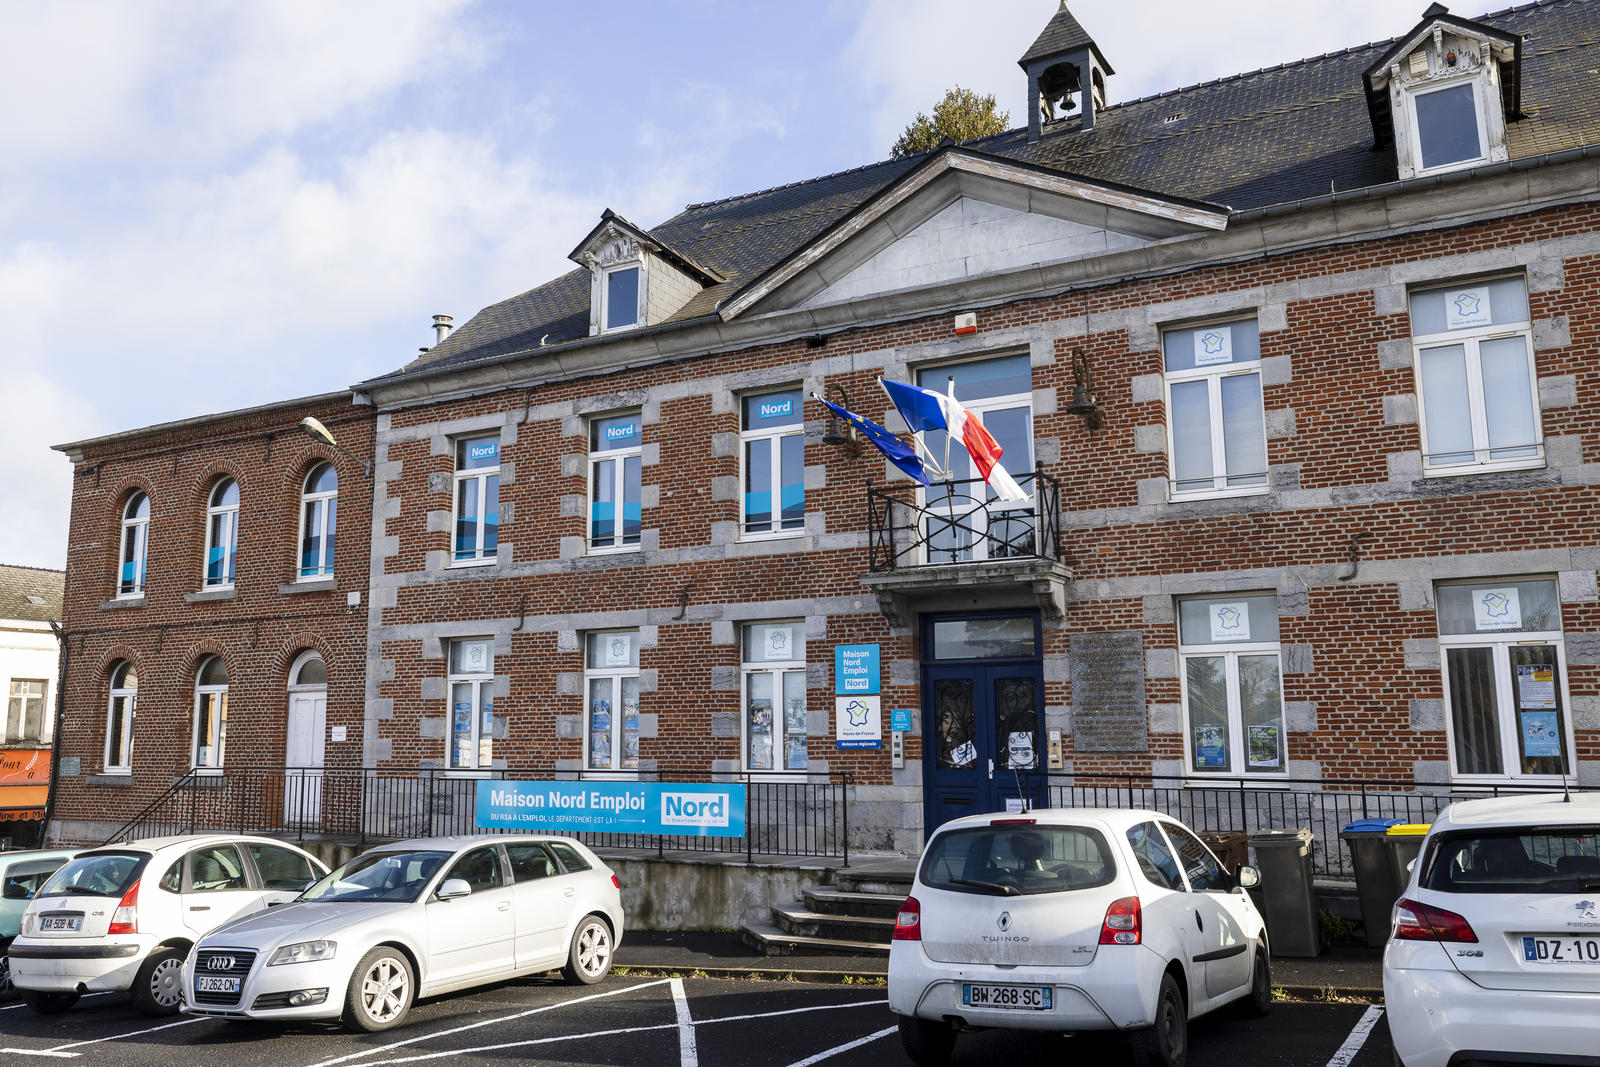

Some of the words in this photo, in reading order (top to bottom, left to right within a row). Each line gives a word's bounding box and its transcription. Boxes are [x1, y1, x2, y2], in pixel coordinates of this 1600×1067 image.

[761, 400, 791, 415] Nord
[607, 424, 633, 437] Nord
[471, 445, 495, 456] Nord
[843, 650, 870, 658] Maison
[843, 658, 861, 666] Nord
[843, 666, 868, 675] Emploi
[846, 679, 867, 687] Nord
[490, 789, 545, 808] Maison
[548, 791, 586, 809] Nord
[590, 792, 646, 814] Emploi
[665, 795, 724, 818] Nord
[499, 813, 512, 821] RSA
[518, 813, 547, 823] L'EMPLOI,
[981, 935, 1030, 943] TWINGO
[199, 978, 235, 991] FJ-262-CN
[971, 987, 1041, 1006] BW-268-SC
